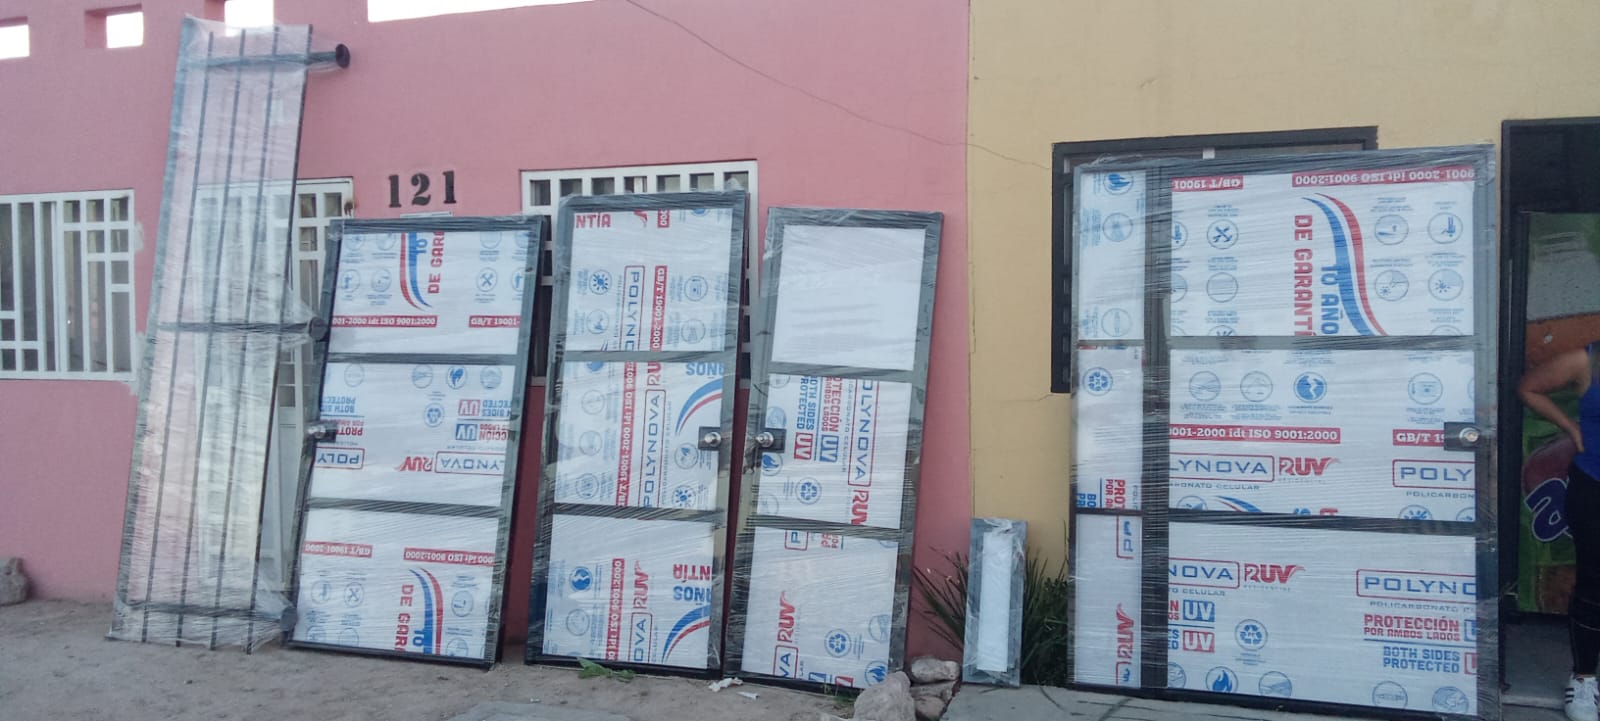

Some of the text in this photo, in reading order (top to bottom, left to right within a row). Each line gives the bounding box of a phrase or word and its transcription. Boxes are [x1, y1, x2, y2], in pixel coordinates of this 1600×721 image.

[388, 171, 457, 208] 121
[1294, 215, 1313, 241] DE
[428, 273, 442, 294] DE
[1250, 429, 1272, 439] ISO
[1275, 430, 1338, 441] 9001:2000
[1396, 432, 1431, 445] GB/T
[794, 432, 813, 460] UV
[820, 434, 839, 462] UV
[1400, 466, 1473, 482] POLY
[400, 584, 414, 607] DE
[1183, 599, 1215, 623] UV
[1363, 613, 1460, 632] PROTECCIÓN
[1182, 630, 1215, 653] UV
[1363, 626, 1460, 642] POR AMBOS LADOS
[1383, 645, 1460, 662] BOTH SIDES
[1383, 657, 1460, 674] PROTECTED
